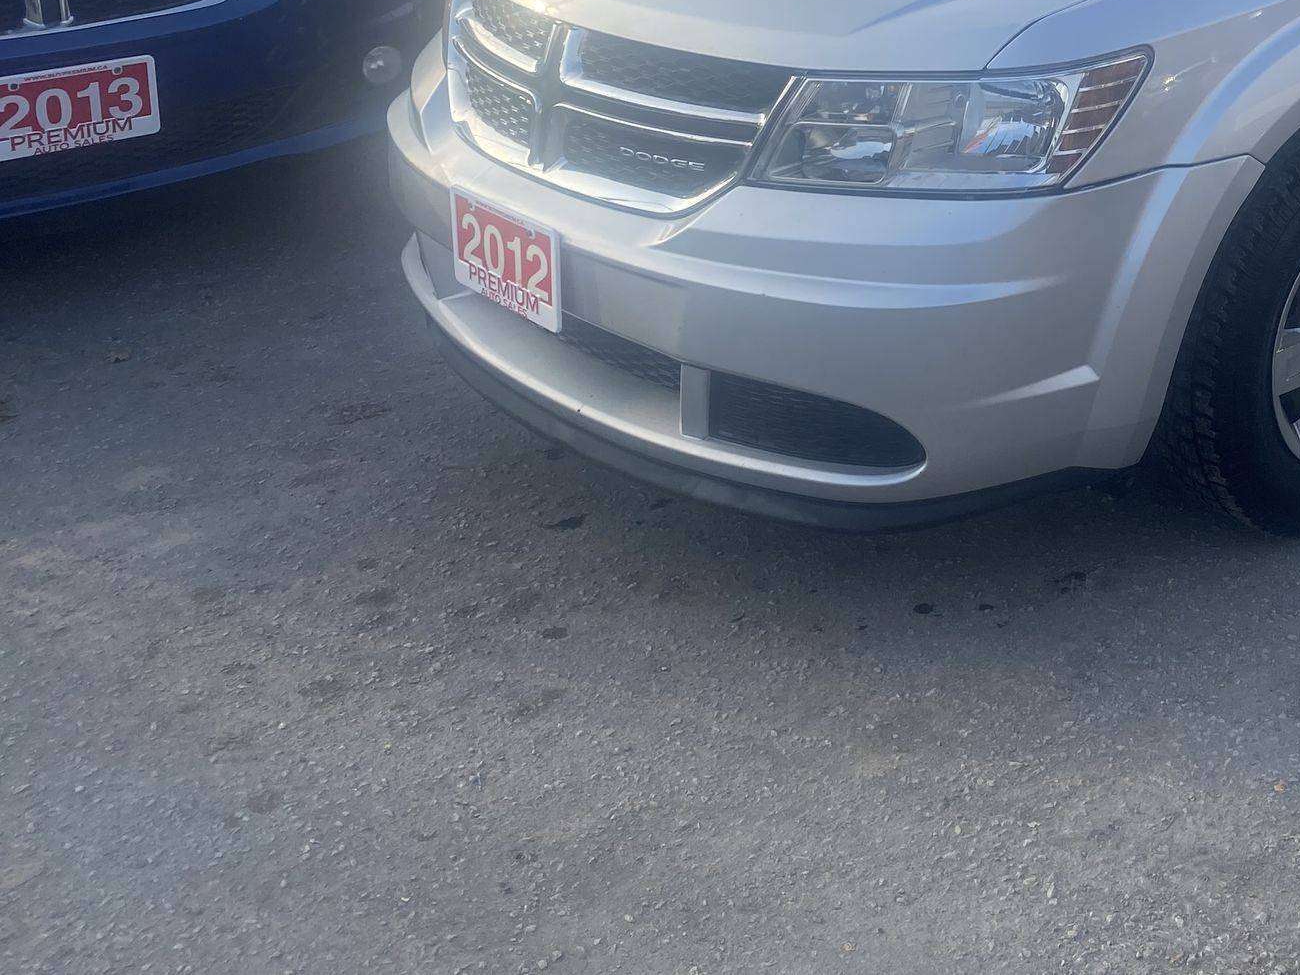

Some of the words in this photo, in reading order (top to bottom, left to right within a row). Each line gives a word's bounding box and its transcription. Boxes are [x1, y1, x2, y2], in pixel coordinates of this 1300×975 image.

[0, 77, 143, 134] 2013
[10, 116, 133, 151] PREMIUM
[34, 142, 70, 156] AUTO
[75, 135, 114, 149] SALES
[620, 146, 704, 171] DODGE
[461, 213, 549, 302] 2012
[469, 264, 539, 314] PREMIUM
